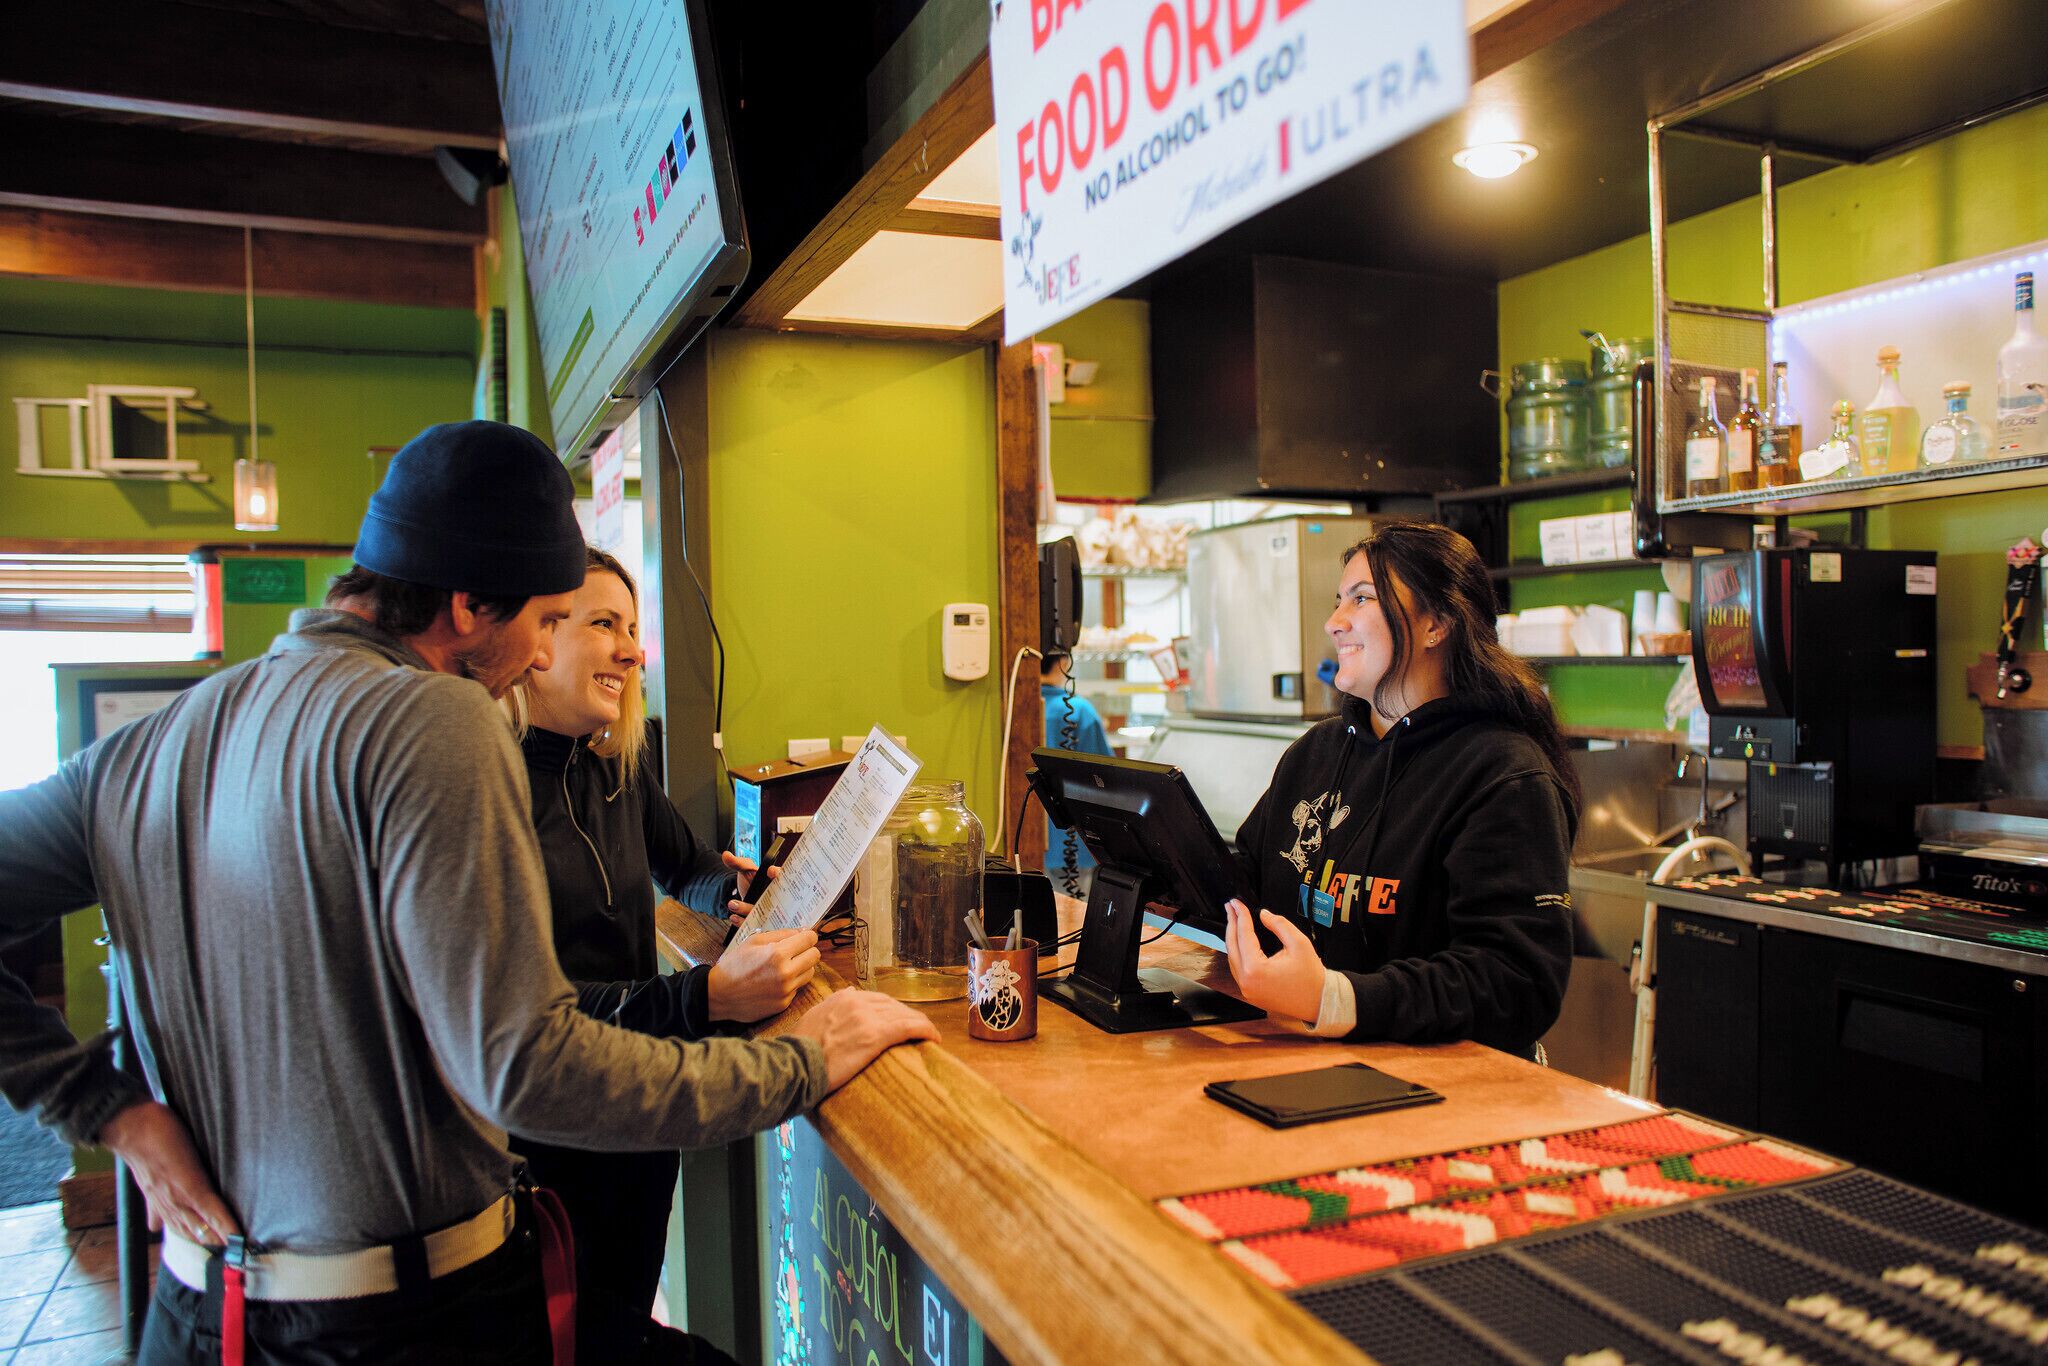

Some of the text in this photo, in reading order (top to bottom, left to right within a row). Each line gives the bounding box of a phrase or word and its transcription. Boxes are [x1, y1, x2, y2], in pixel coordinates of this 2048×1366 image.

[1017, 47, 1130, 214] FOOD
[1084, 34, 1305, 212] NO ALCOHOL TO GO!
[1301, 42, 1440, 156] ULTRA
[1972, 874, 2022, 893] Tito's
[810, 1167, 914, 1366] ALCOHOL
[813, 1253, 844, 1353] TO
